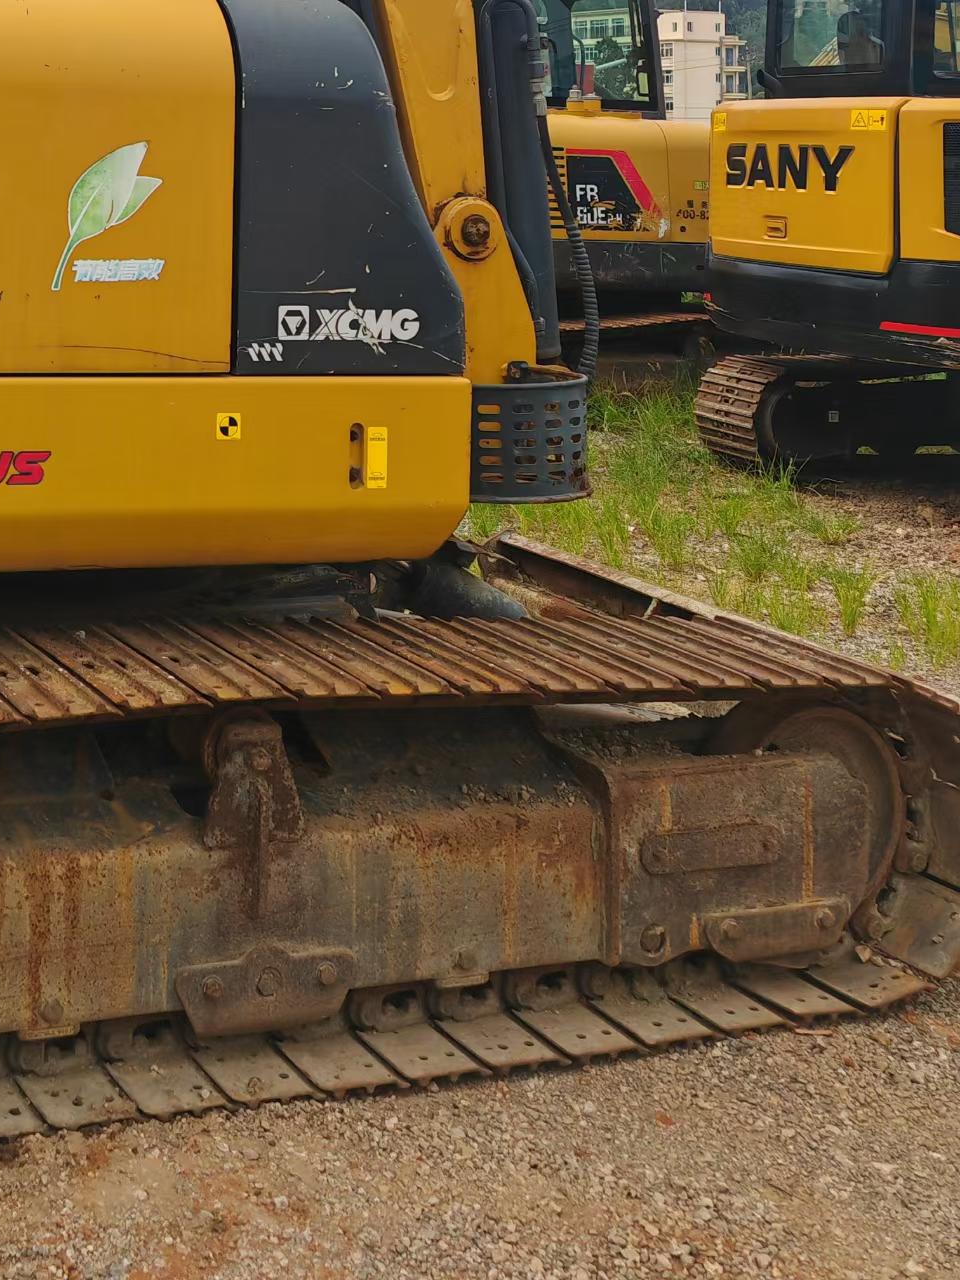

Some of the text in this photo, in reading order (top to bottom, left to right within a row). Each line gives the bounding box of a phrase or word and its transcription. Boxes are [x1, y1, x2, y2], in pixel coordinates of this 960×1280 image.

[726, 143, 855, 194] SANY
[575, 184, 599, 202] FR
[309, 308, 420, 342] XCMG
